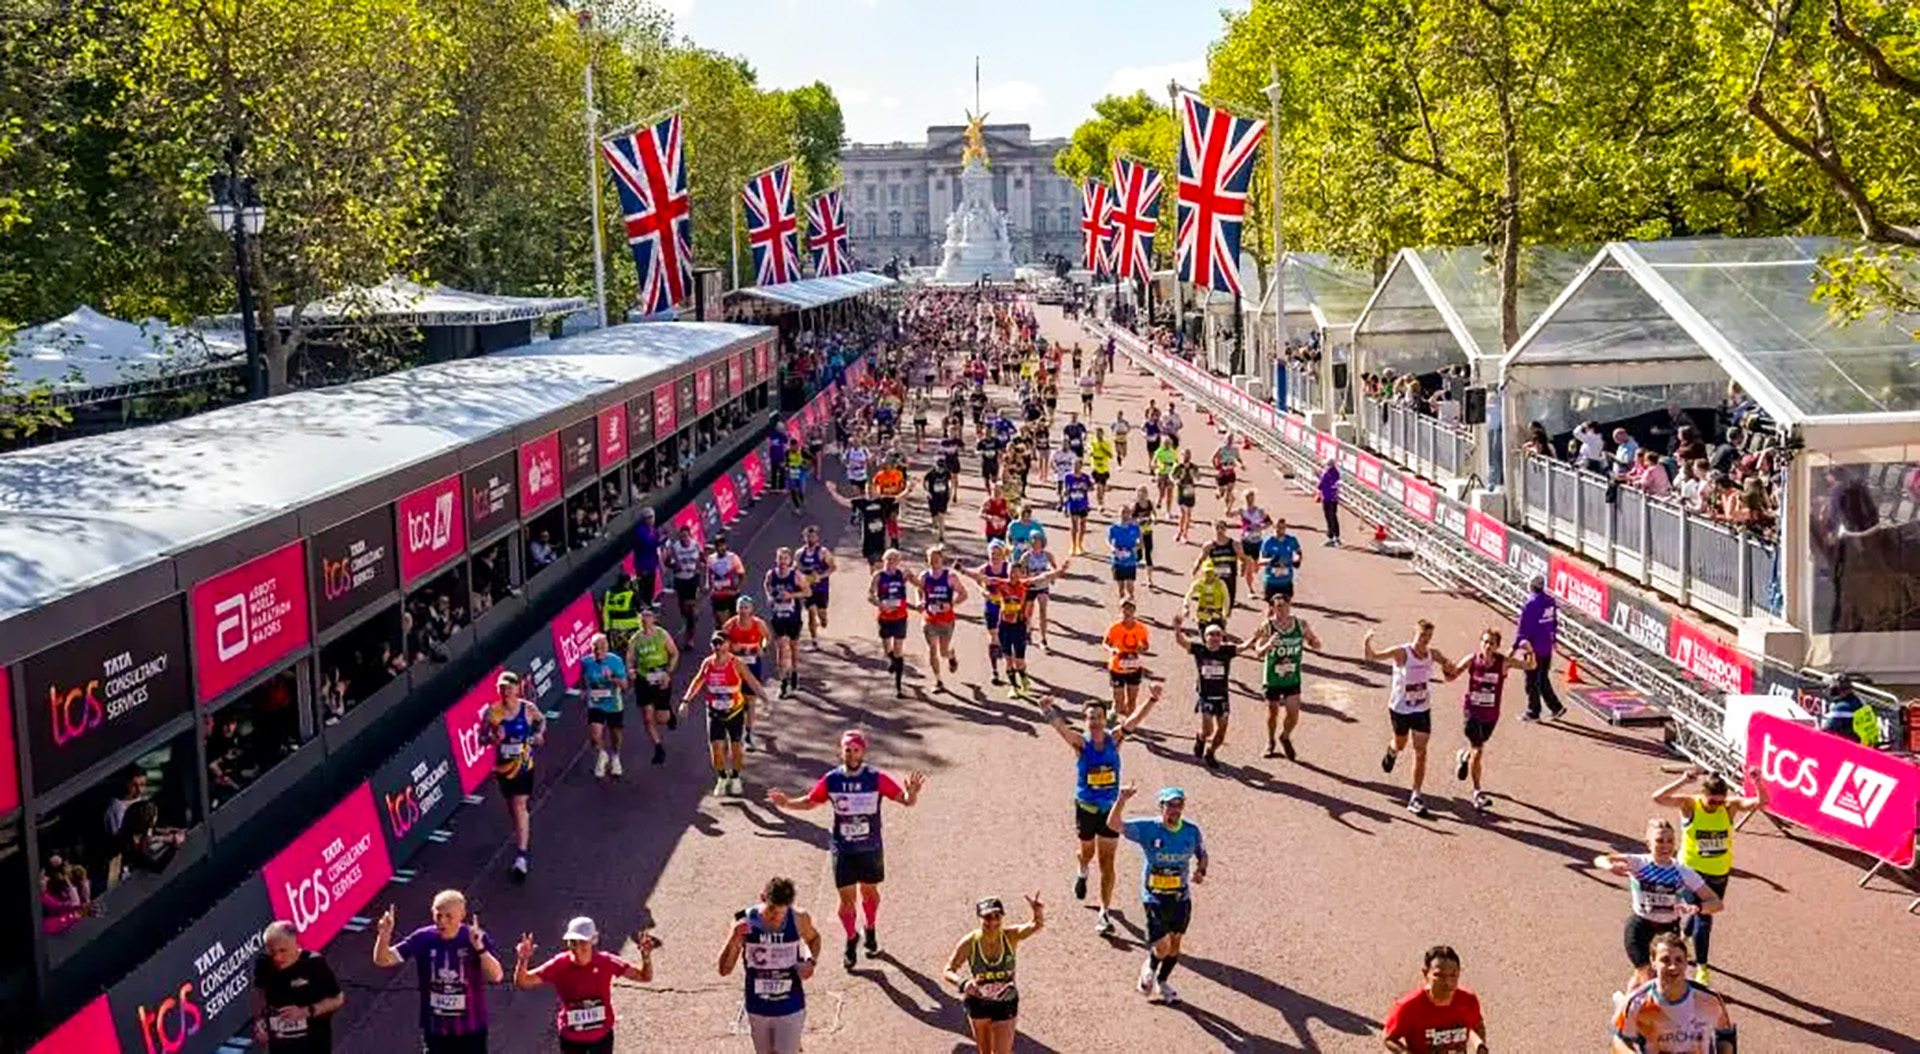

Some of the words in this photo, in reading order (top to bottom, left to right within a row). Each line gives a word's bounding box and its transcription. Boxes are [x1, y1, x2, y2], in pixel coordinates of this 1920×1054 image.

[407, 509, 432, 552] tcs
[249, 578, 277, 602] ABBOTT
[323, 558, 351, 600] tcs
[250, 592, 276, 614] WORLD
[251, 599, 291, 630] MARATHON
[252, 619, 282, 644] MAJORS
[103, 651, 133, 678] TATA
[105, 653, 167, 698] CONSULTANCY
[1706, 652, 1741, 687] LONDON
[50, 680, 102, 747] tcs
[106, 684, 149, 720] SERVICES
[1762, 733, 1818, 797] tcs
[385, 785, 419, 837] tcs
[322, 837, 345, 864] TATA
[327, 833, 371, 883] CONSULTANCY
[285, 868, 331, 933] tcs
[332, 864, 363, 902] SERVICES
[194, 941, 227, 975] TATA
[759, 932, 785, 948] MATT
[200, 929, 264, 998] CONSULTANCY
[206, 970, 249, 1020] SERVICES
[138, 981, 202, 1054] tcs
